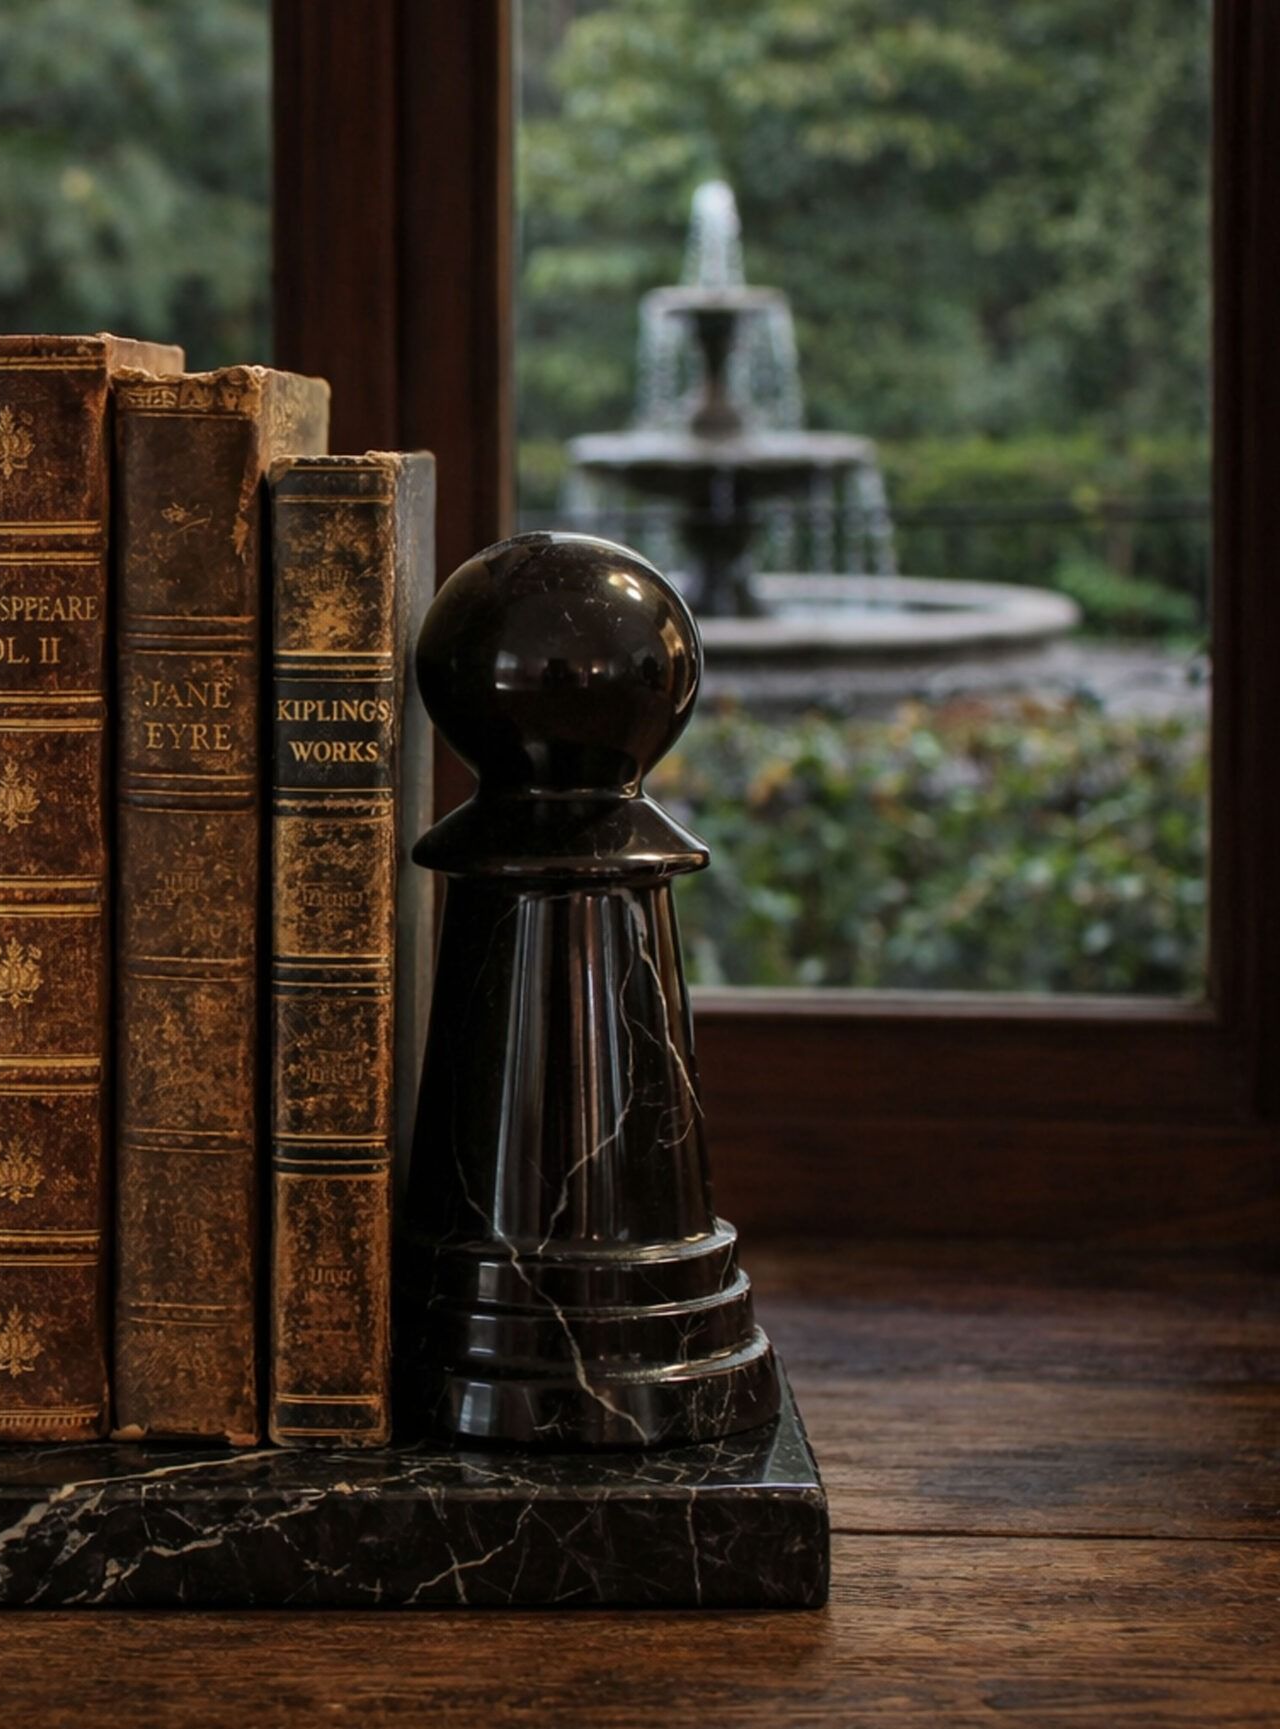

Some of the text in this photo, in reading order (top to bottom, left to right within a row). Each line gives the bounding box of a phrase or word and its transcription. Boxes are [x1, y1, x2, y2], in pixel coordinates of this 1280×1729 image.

[39, 636, 61, 664] II
[146, 680, 232, 708] JANE
[144, 722, 233, 750] EYRE
[288, 741, 380, 762] WORKS
